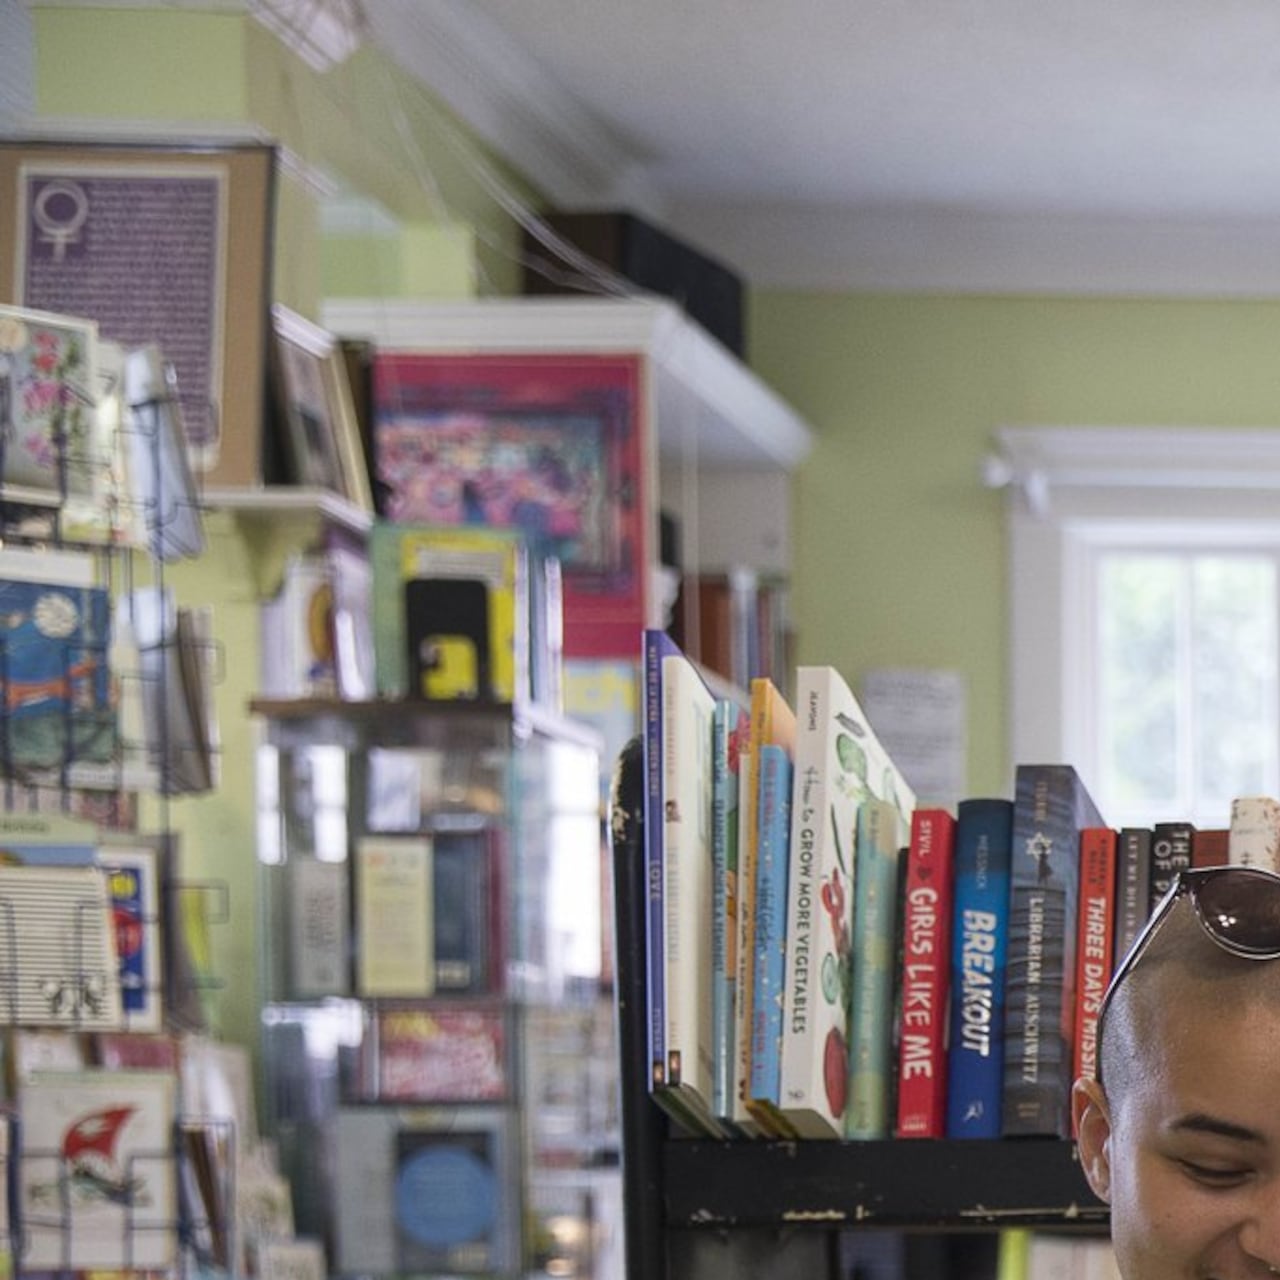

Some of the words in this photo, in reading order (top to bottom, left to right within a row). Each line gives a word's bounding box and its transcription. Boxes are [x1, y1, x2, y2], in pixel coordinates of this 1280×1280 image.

[799, 828, 814, 880] GROW
[1154, 840, 1172, 870] OF
[1172, 830, 1190, 866] THE
[650, 860, 662, 900] LOVE
[797, 883, 812, 930] MORE
[909, 887, 938, 954] GIRLS
[1027, 898, 1044, 984] LIBRARIAN
[1083, 897, 1107, 958] THREE
[791, 934, 811, 1034] VEGETABLES
[904, 964, 935, 1026] LIKE
[962, 909, 997, 1057] BREAKOUT
[1083, 964, 1104, 1013] DAYS
[902, 1035, 932, 1081] ME
[1022, 993, 1040, 1083] AUSCHWITZ
[1080, 1018, 1099, 1081] MISSIN
